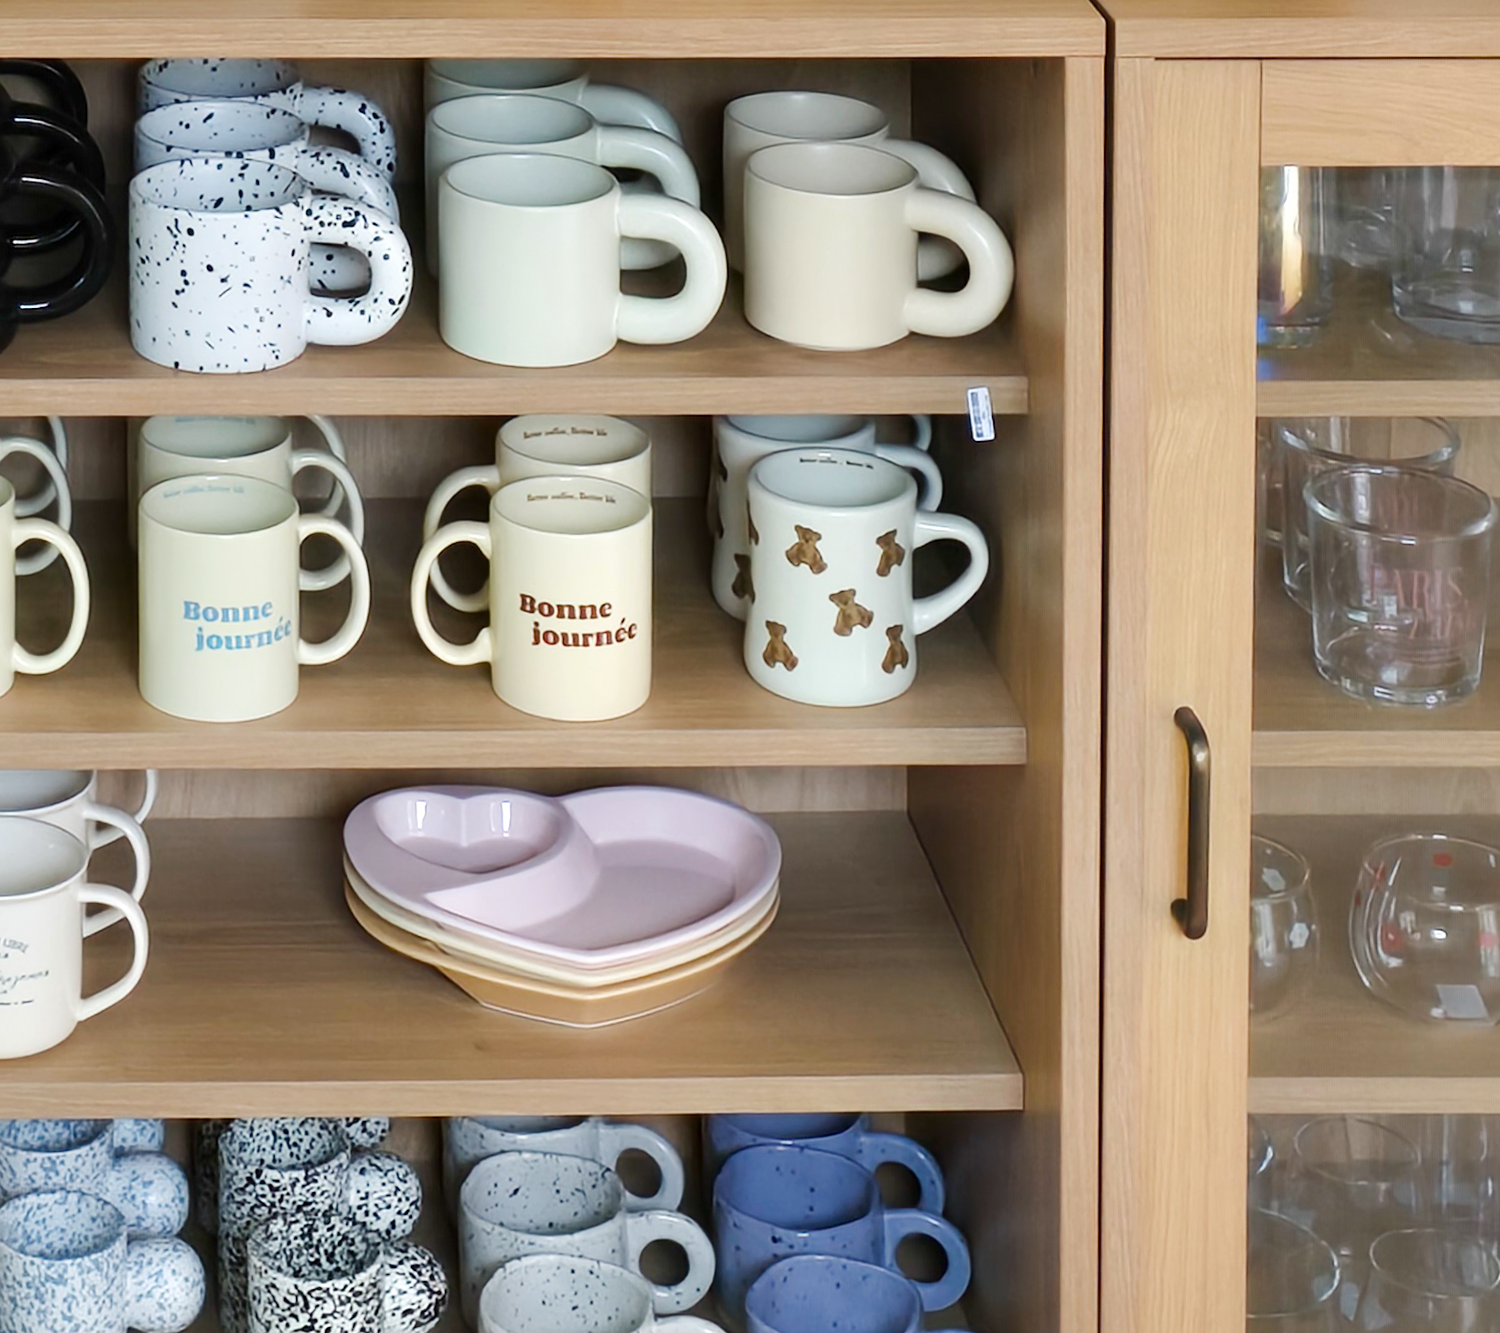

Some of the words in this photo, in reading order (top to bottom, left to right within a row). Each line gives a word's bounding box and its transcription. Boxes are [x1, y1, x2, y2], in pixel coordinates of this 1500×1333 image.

[183, 600, 273, 623] Bonne
[519, 593, 612, 620] Bonne
[195, 616, 292, 651] journée
[532, 618, 637, 647] journée
